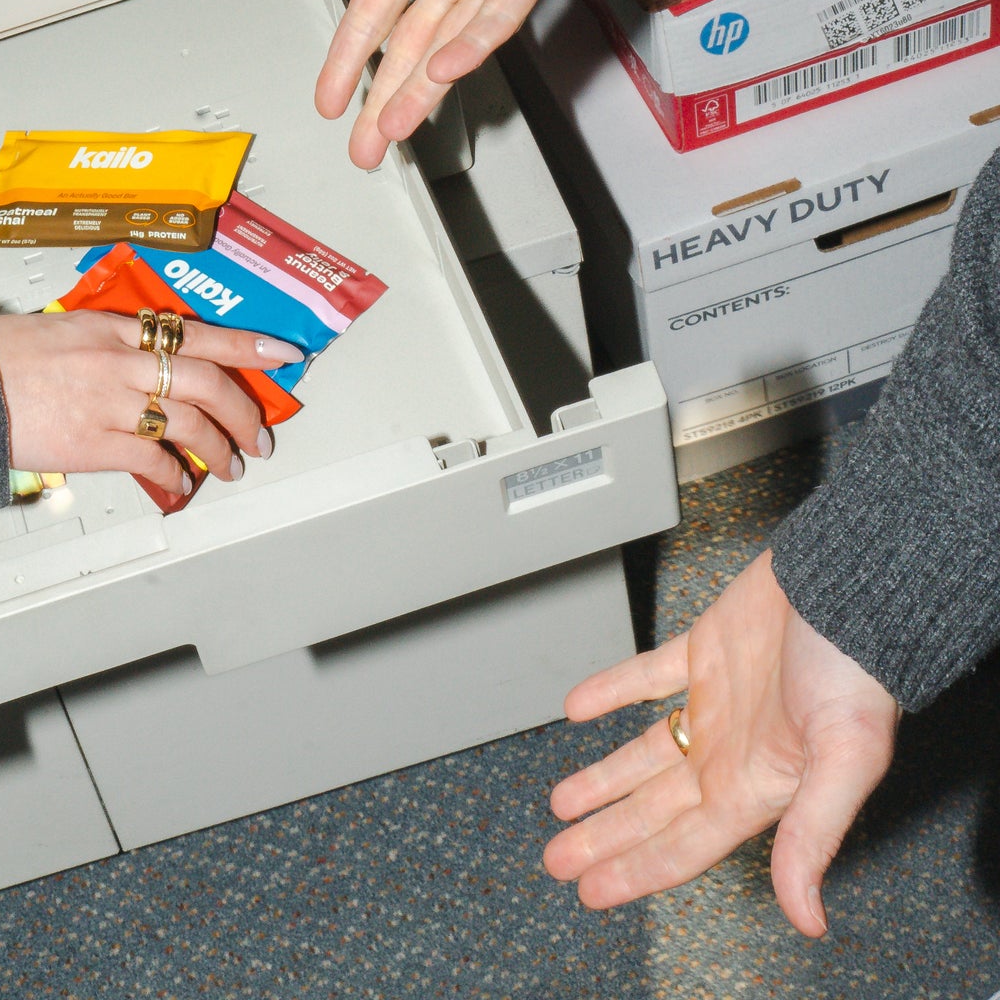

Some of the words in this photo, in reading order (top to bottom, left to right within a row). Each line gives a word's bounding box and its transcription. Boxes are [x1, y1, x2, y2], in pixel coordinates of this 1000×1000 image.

[707, 12, 744, 55] hp
[68, 146, 154, 169] kailo
[68, 191, 101, 200] Actually
[101, 191, 122, 200] Good
[122, 191, 138, 200] Bar
[652, 208, 779, 271] HEAVY
[788, 168, 891, 224] DUTY
[129, 230, 145, 239] 14g
[148, 231, 187, 240] PROTEIN
[236, 224, 268, 244] TRANSPARENT
[231, 247, 261, 270] Actually
[257, 261, 272, 275] An
[294, 251, 344, 287] Butter
[343, 263, 358, 274] NET
[284, 255, 337, 293] Peanut
[163, 258, 245, 317] kailo
[668, 285, 791, 332] CONTENTS:
[793, 355, 838, 375] LOCATION
[827, 376, 857, 393] 12PK
[513, 468, 584, 500] LETTER
